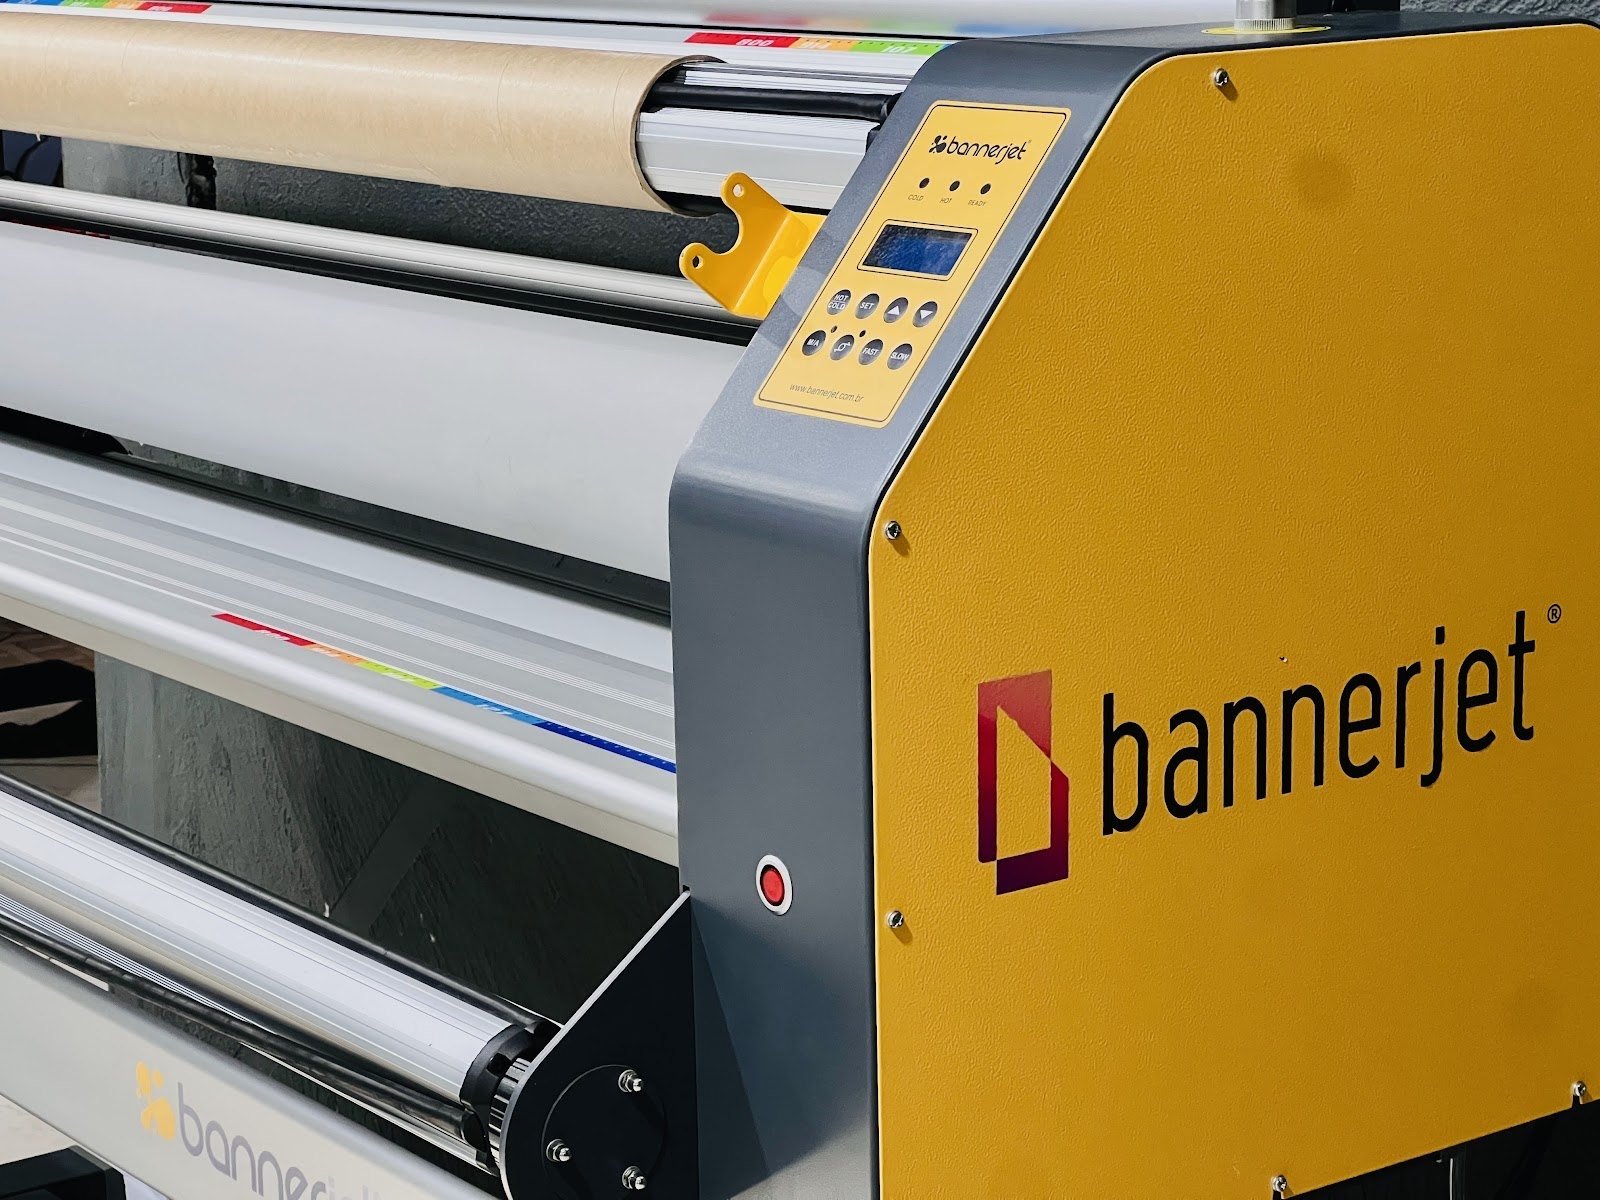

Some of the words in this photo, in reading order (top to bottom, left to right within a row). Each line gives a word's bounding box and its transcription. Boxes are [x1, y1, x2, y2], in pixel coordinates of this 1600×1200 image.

[946, 136, 1027, 165] bannerjet
[907, 194, 924, 202] COLD
[968, 199, 986, 207] READY
[828, 302, 846, 310] COLD
[834, 294, 849, 302] HOT
[860, 302, 875, 310] SET
[863, 348, 879, 356] FAST
[891, 351, 909, 361] SLOW
[789, 383, 864, 403] www.bannerjet.com.br
[1102, 610, 1536, 836] bannerjet
